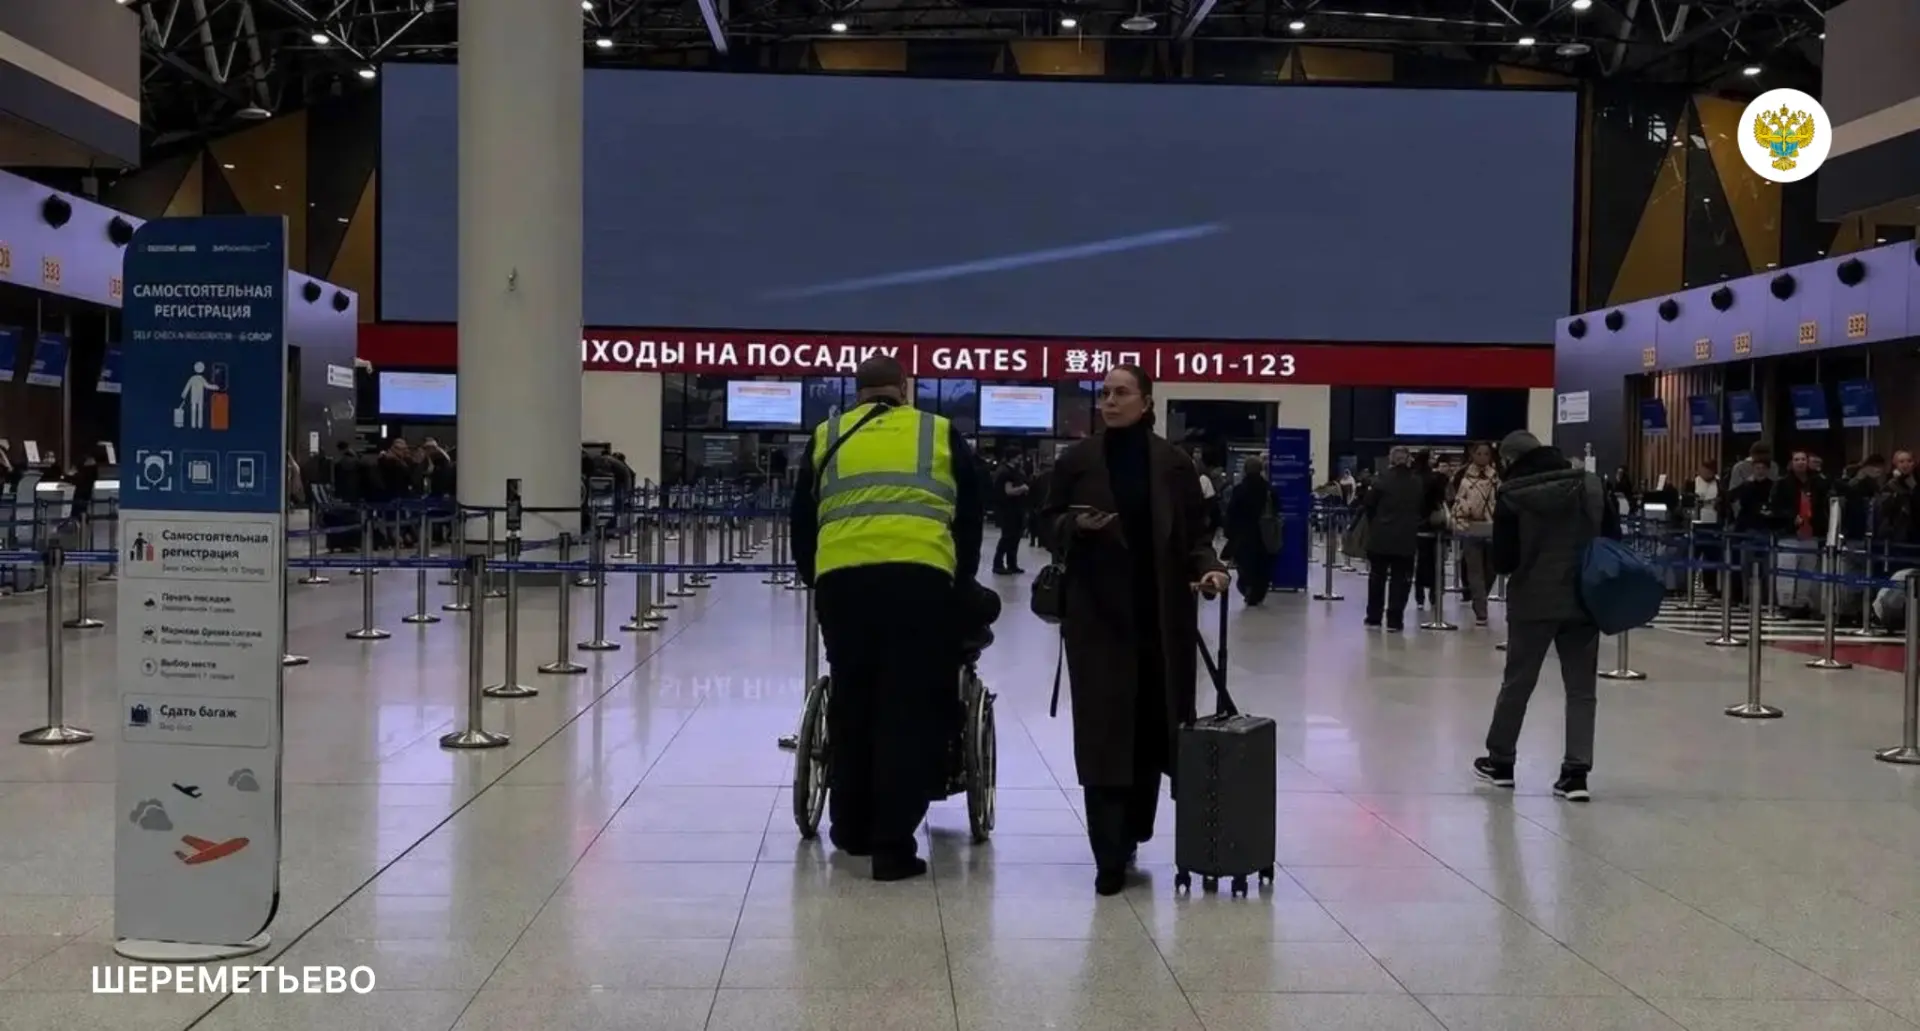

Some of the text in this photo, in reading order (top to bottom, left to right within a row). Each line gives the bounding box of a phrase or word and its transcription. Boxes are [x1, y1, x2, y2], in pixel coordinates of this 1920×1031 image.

[133, 284, 272, 297] САМОСТОЯТЕЛЬНАЯ
[154, 304, 252, 320] РЕГИСТРАЦИЯ
[581, 340, 685, 368] ХОДЫ
[696, 342, 738, 365] НА
[932, 347, 1028, 371] GATES
[1174, 352, 1296, 376] 101-123
[162, 529, 269, 544] Самостоятельная
[162, 548, 239, 561] регистрация
[160, 704, 238, 719] Сдать багаж
